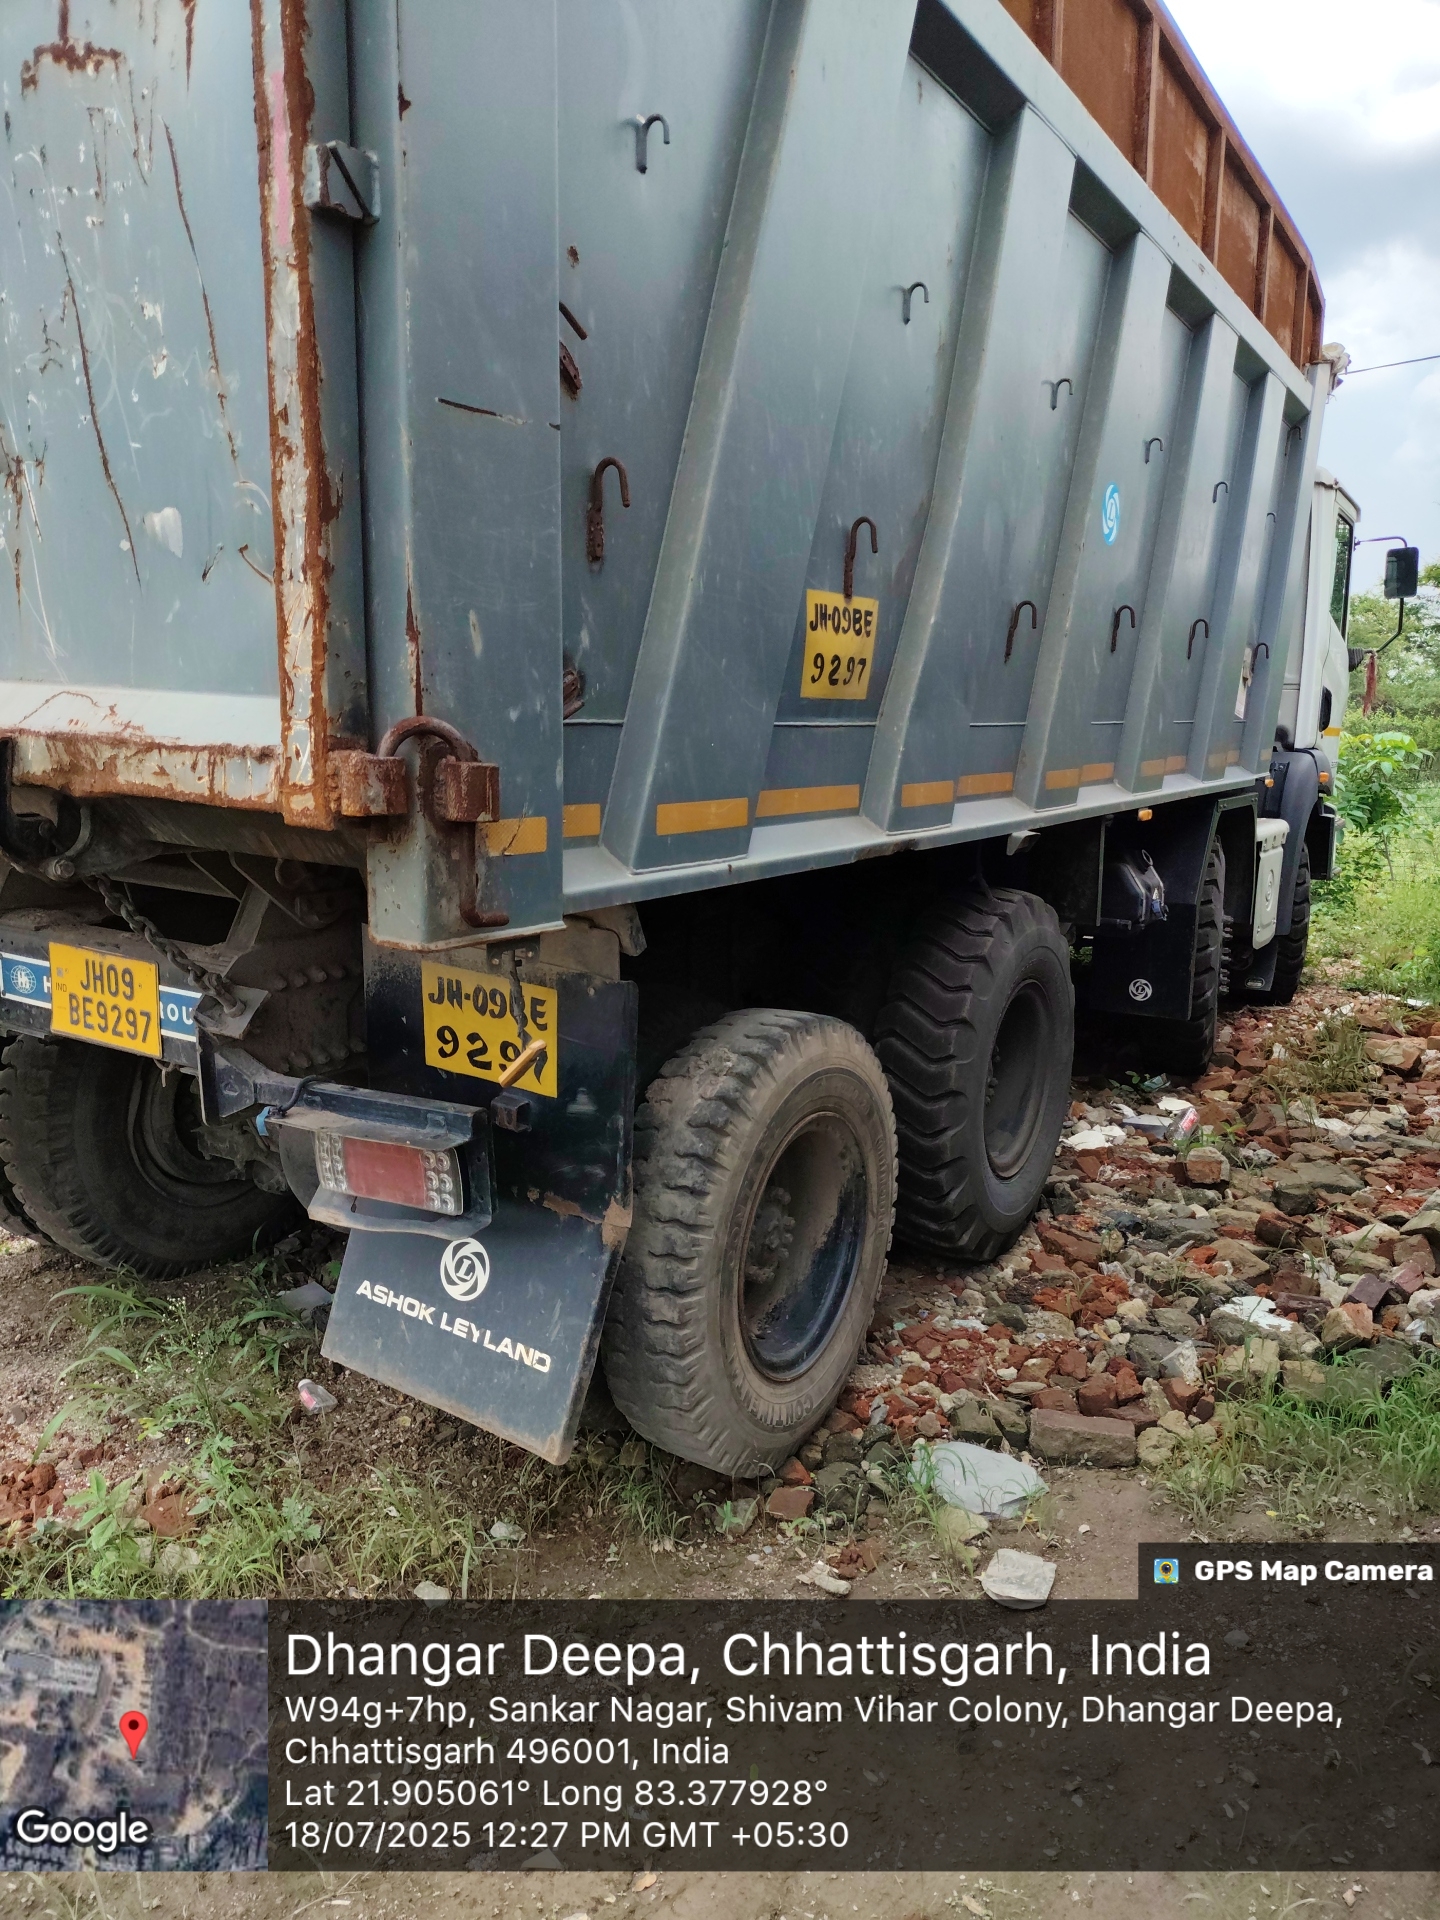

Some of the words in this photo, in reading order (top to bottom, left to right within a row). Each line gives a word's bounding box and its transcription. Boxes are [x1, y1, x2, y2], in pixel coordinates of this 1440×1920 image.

[809, 603, 874, 638] JH-09BE
[810, 652, 867, 687] 9297
[80, 958, 135, 1001] JH09
[68, 992, 153, 1044] BE9297
[356, 1280, 436, 1325] ASHOK
[440, 1312, 552, 1373] LEYLAND
